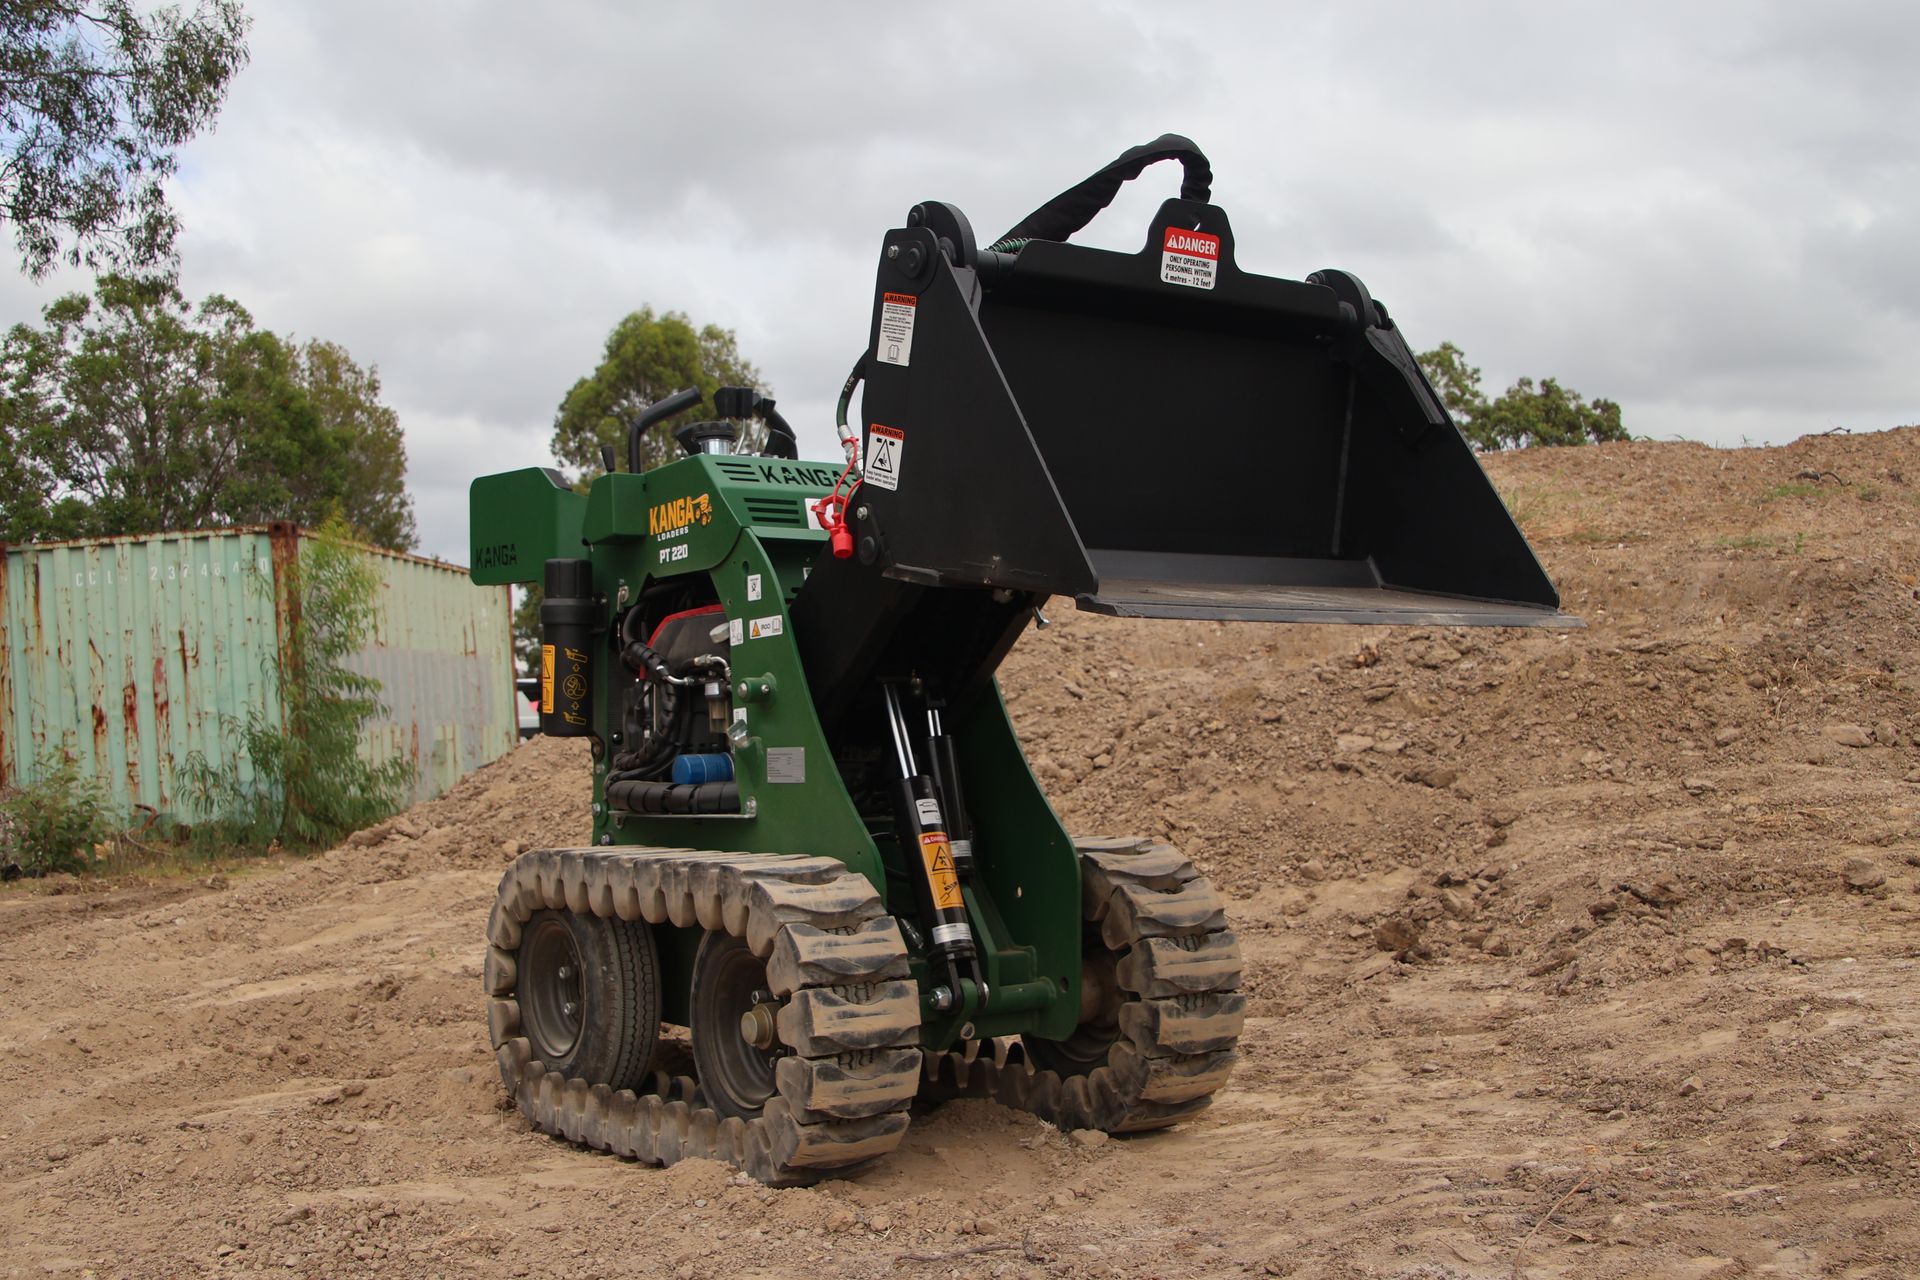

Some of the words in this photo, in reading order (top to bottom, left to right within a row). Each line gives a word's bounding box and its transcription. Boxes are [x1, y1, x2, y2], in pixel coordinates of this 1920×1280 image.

[1179, 236, 1216, 255] DANGER
[1169, 255, 1182, 264] ONLY
[1183, 257, 1210, 269] OPERATING
[1166, 264, 1192, 275] PERSONNEL
[1193, 268, 1212, 278] WITHIN
[1164, 272, 1169, 280] 4
[1169, 274, 1187, 283] metres
[1192, 277, 1200, 286] 12
[1200, 278, 1211, 287] feet
[890, 295, 915, 305] WARNING
[875, 425, 903, 438] WARNING
[758, 465, 852, 489] KANGA
[649, 496, 695, 536] KANGA
[657, 526, 689, 542] LOADERS
[475, 544, 518, 569] KANGA
[659, 548, 671, 564] PT
[671, 543, 688, 561] 220
